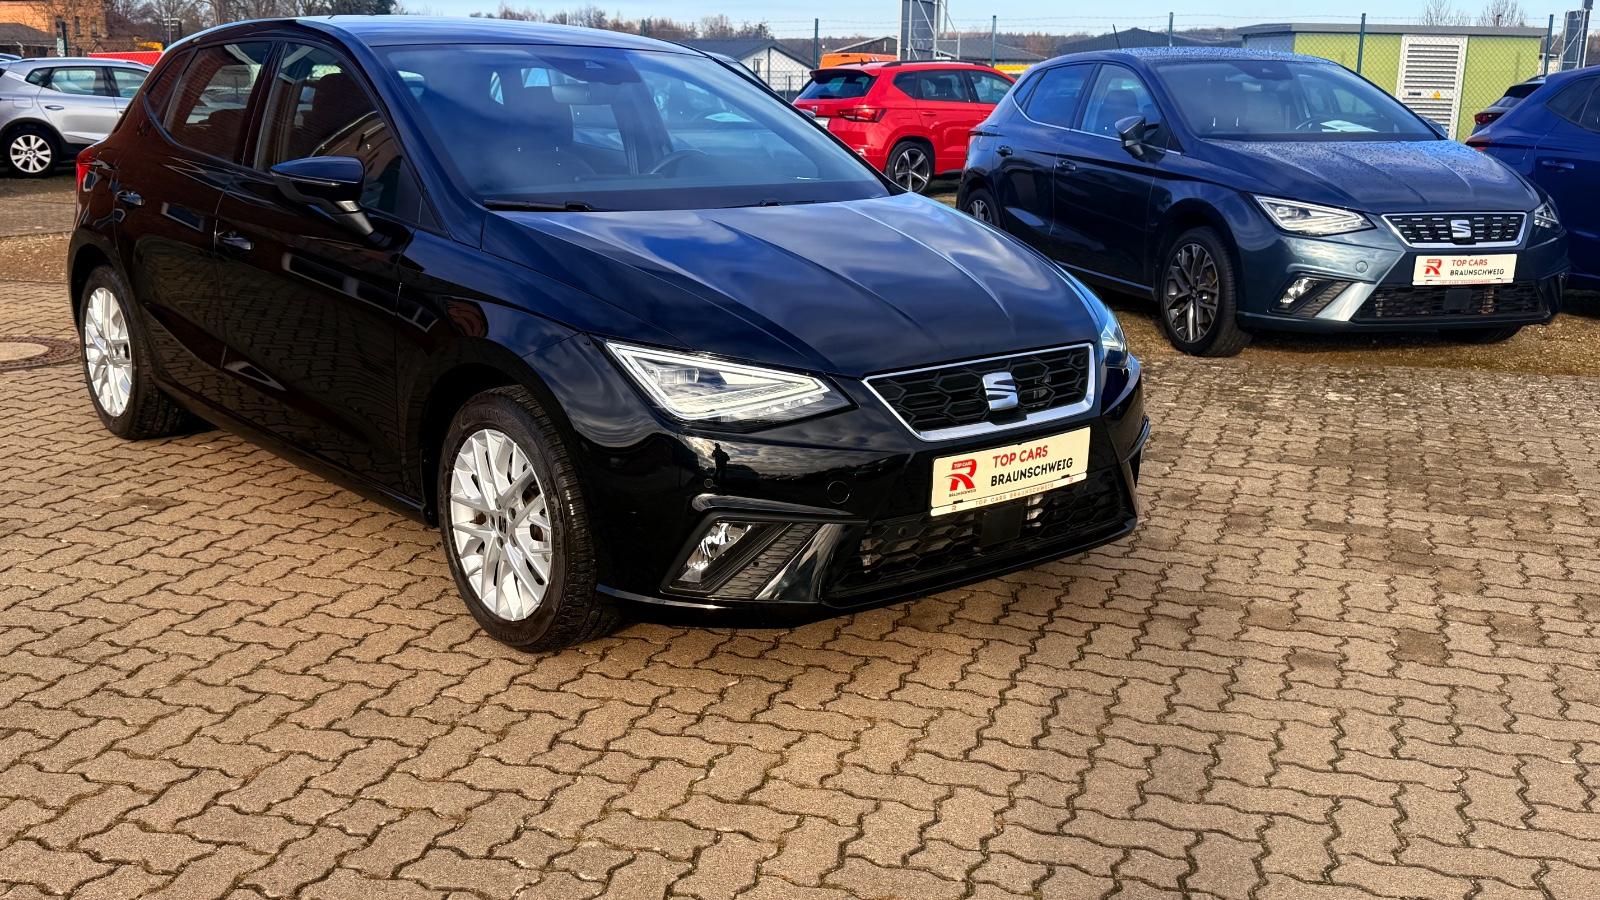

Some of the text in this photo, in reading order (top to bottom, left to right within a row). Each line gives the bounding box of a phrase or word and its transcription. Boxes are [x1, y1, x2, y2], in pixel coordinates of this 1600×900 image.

[1451, 259, 1467, 267] TOP
[1449, 268, 1505, 276] BRAUNSCHWEIG
[992, 445, 1049, 469] TOP CARS
[990, 457, 1074, 487] BRAUNSCHWEIG
[975, 497, 988, 506] TOP
[990, 494, 1007, 503] CARS
